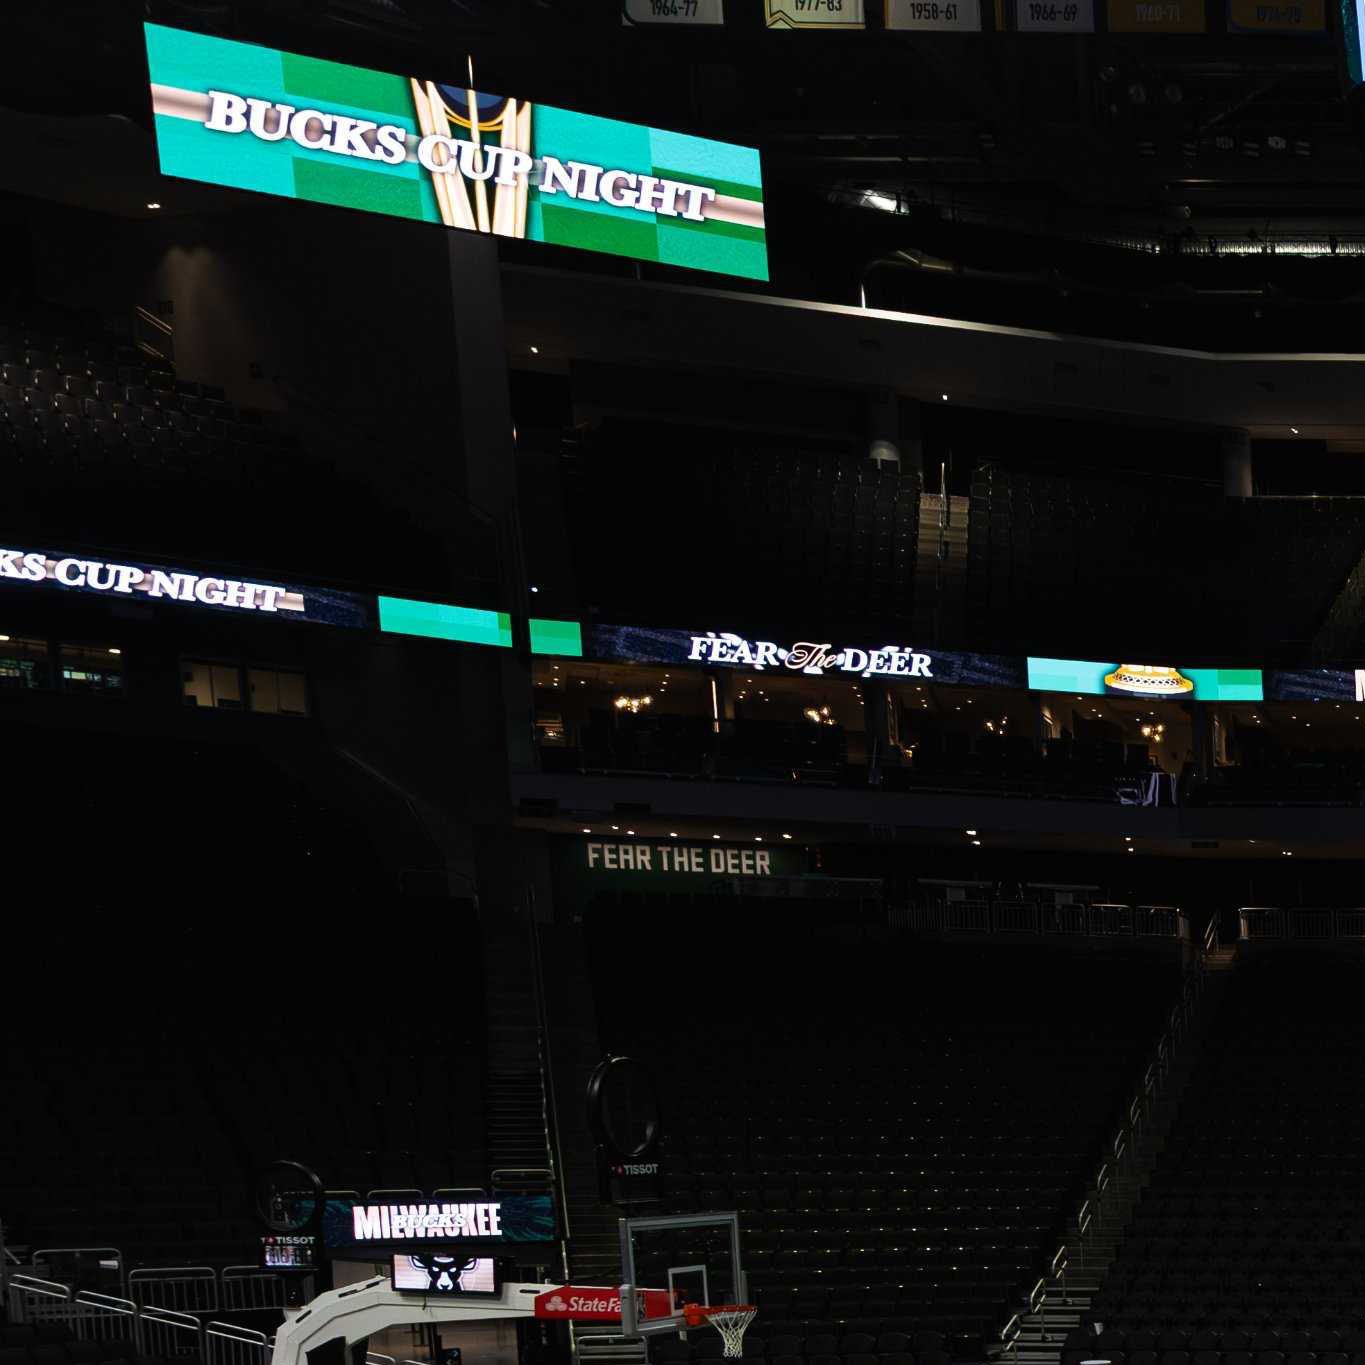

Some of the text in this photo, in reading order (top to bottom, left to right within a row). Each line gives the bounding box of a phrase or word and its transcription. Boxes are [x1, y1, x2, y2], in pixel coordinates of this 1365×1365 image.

[911, 2, 958, 21] 1958-61
[204, 90, 716, 221] BUCKS CUP NIGHT
[54, 558, 145, 593] CUP
[148, 570, 286, 612] NIGHT
[688, 636, 933, 678] FEAR The DEER
[586, 842, 772, 875] FEAR THE DEER
[623, 1163, 659, 1176] TISSOT
[352, 1203, 503, 1240] MILWAUKEE
[392, 1213, 468, 1229] BUCKS
[275, 1235, 317, 1246] TISSOT
